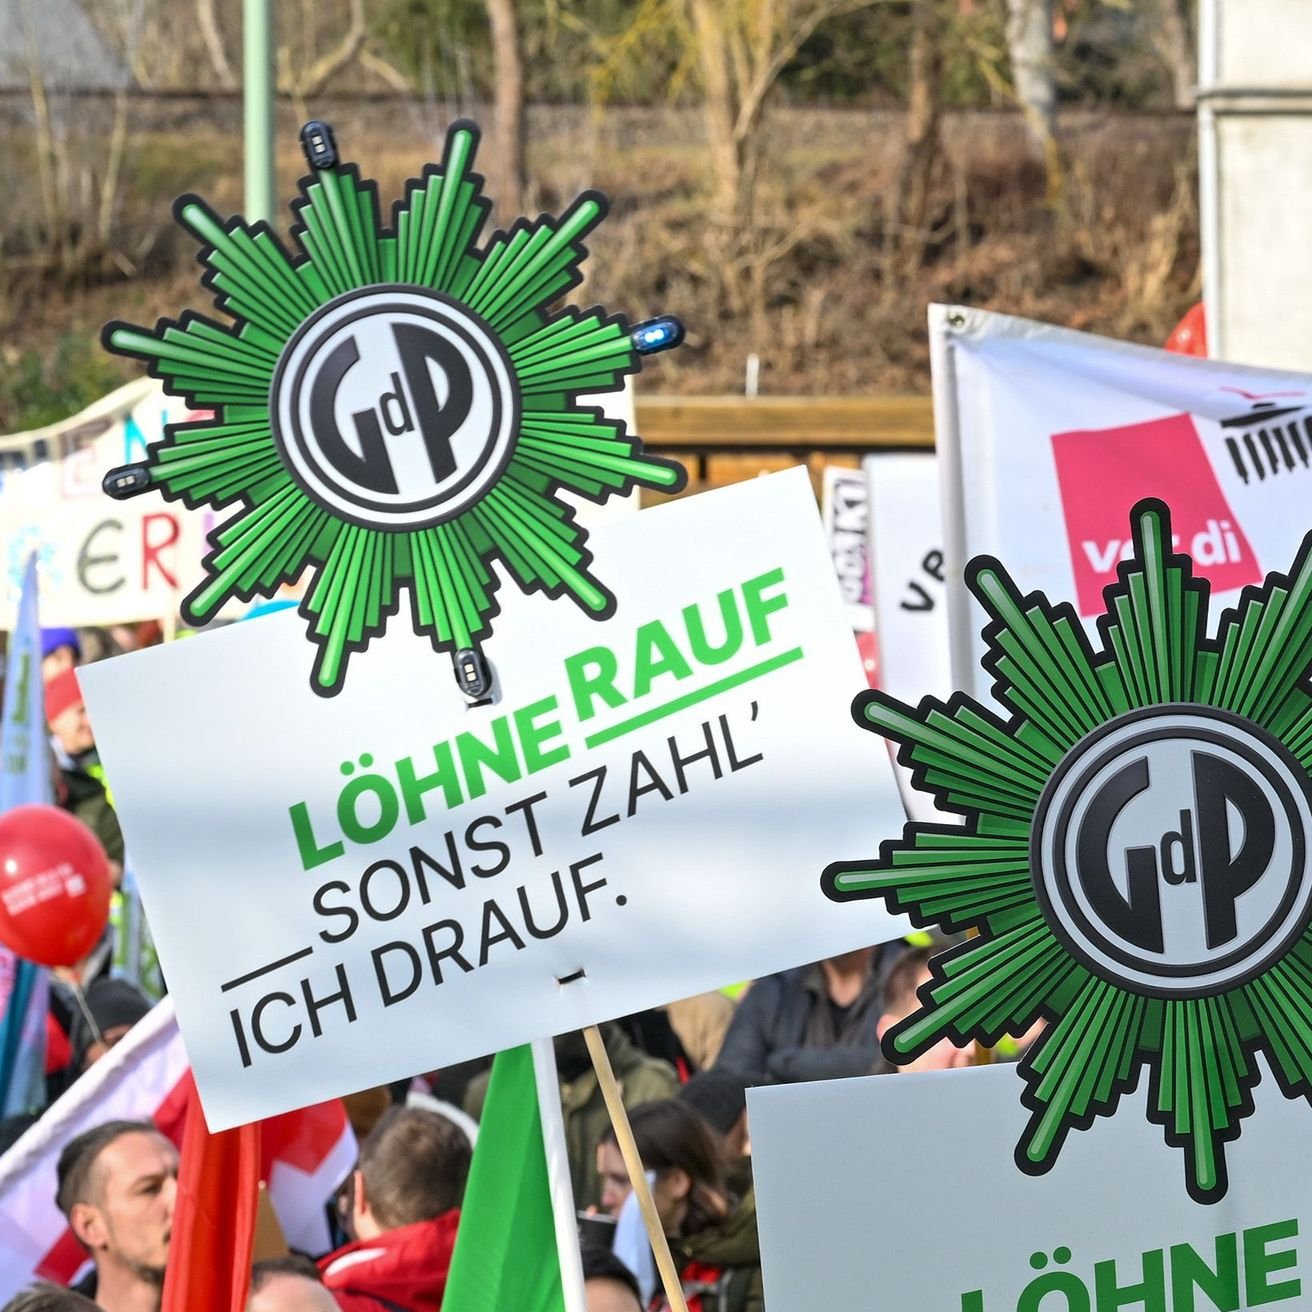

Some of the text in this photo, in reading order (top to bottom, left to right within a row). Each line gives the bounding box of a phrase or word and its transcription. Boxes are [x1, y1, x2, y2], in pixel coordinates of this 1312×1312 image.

[311, 323, 474, 495] GdP
[289, 567, 786, 871] LÖHNE RAUF
[313, 790, 548, 943] SONST
[1077, 750, 1276, 954] GdP
[230, 853, 629, 1068] ICH DRAUF.
